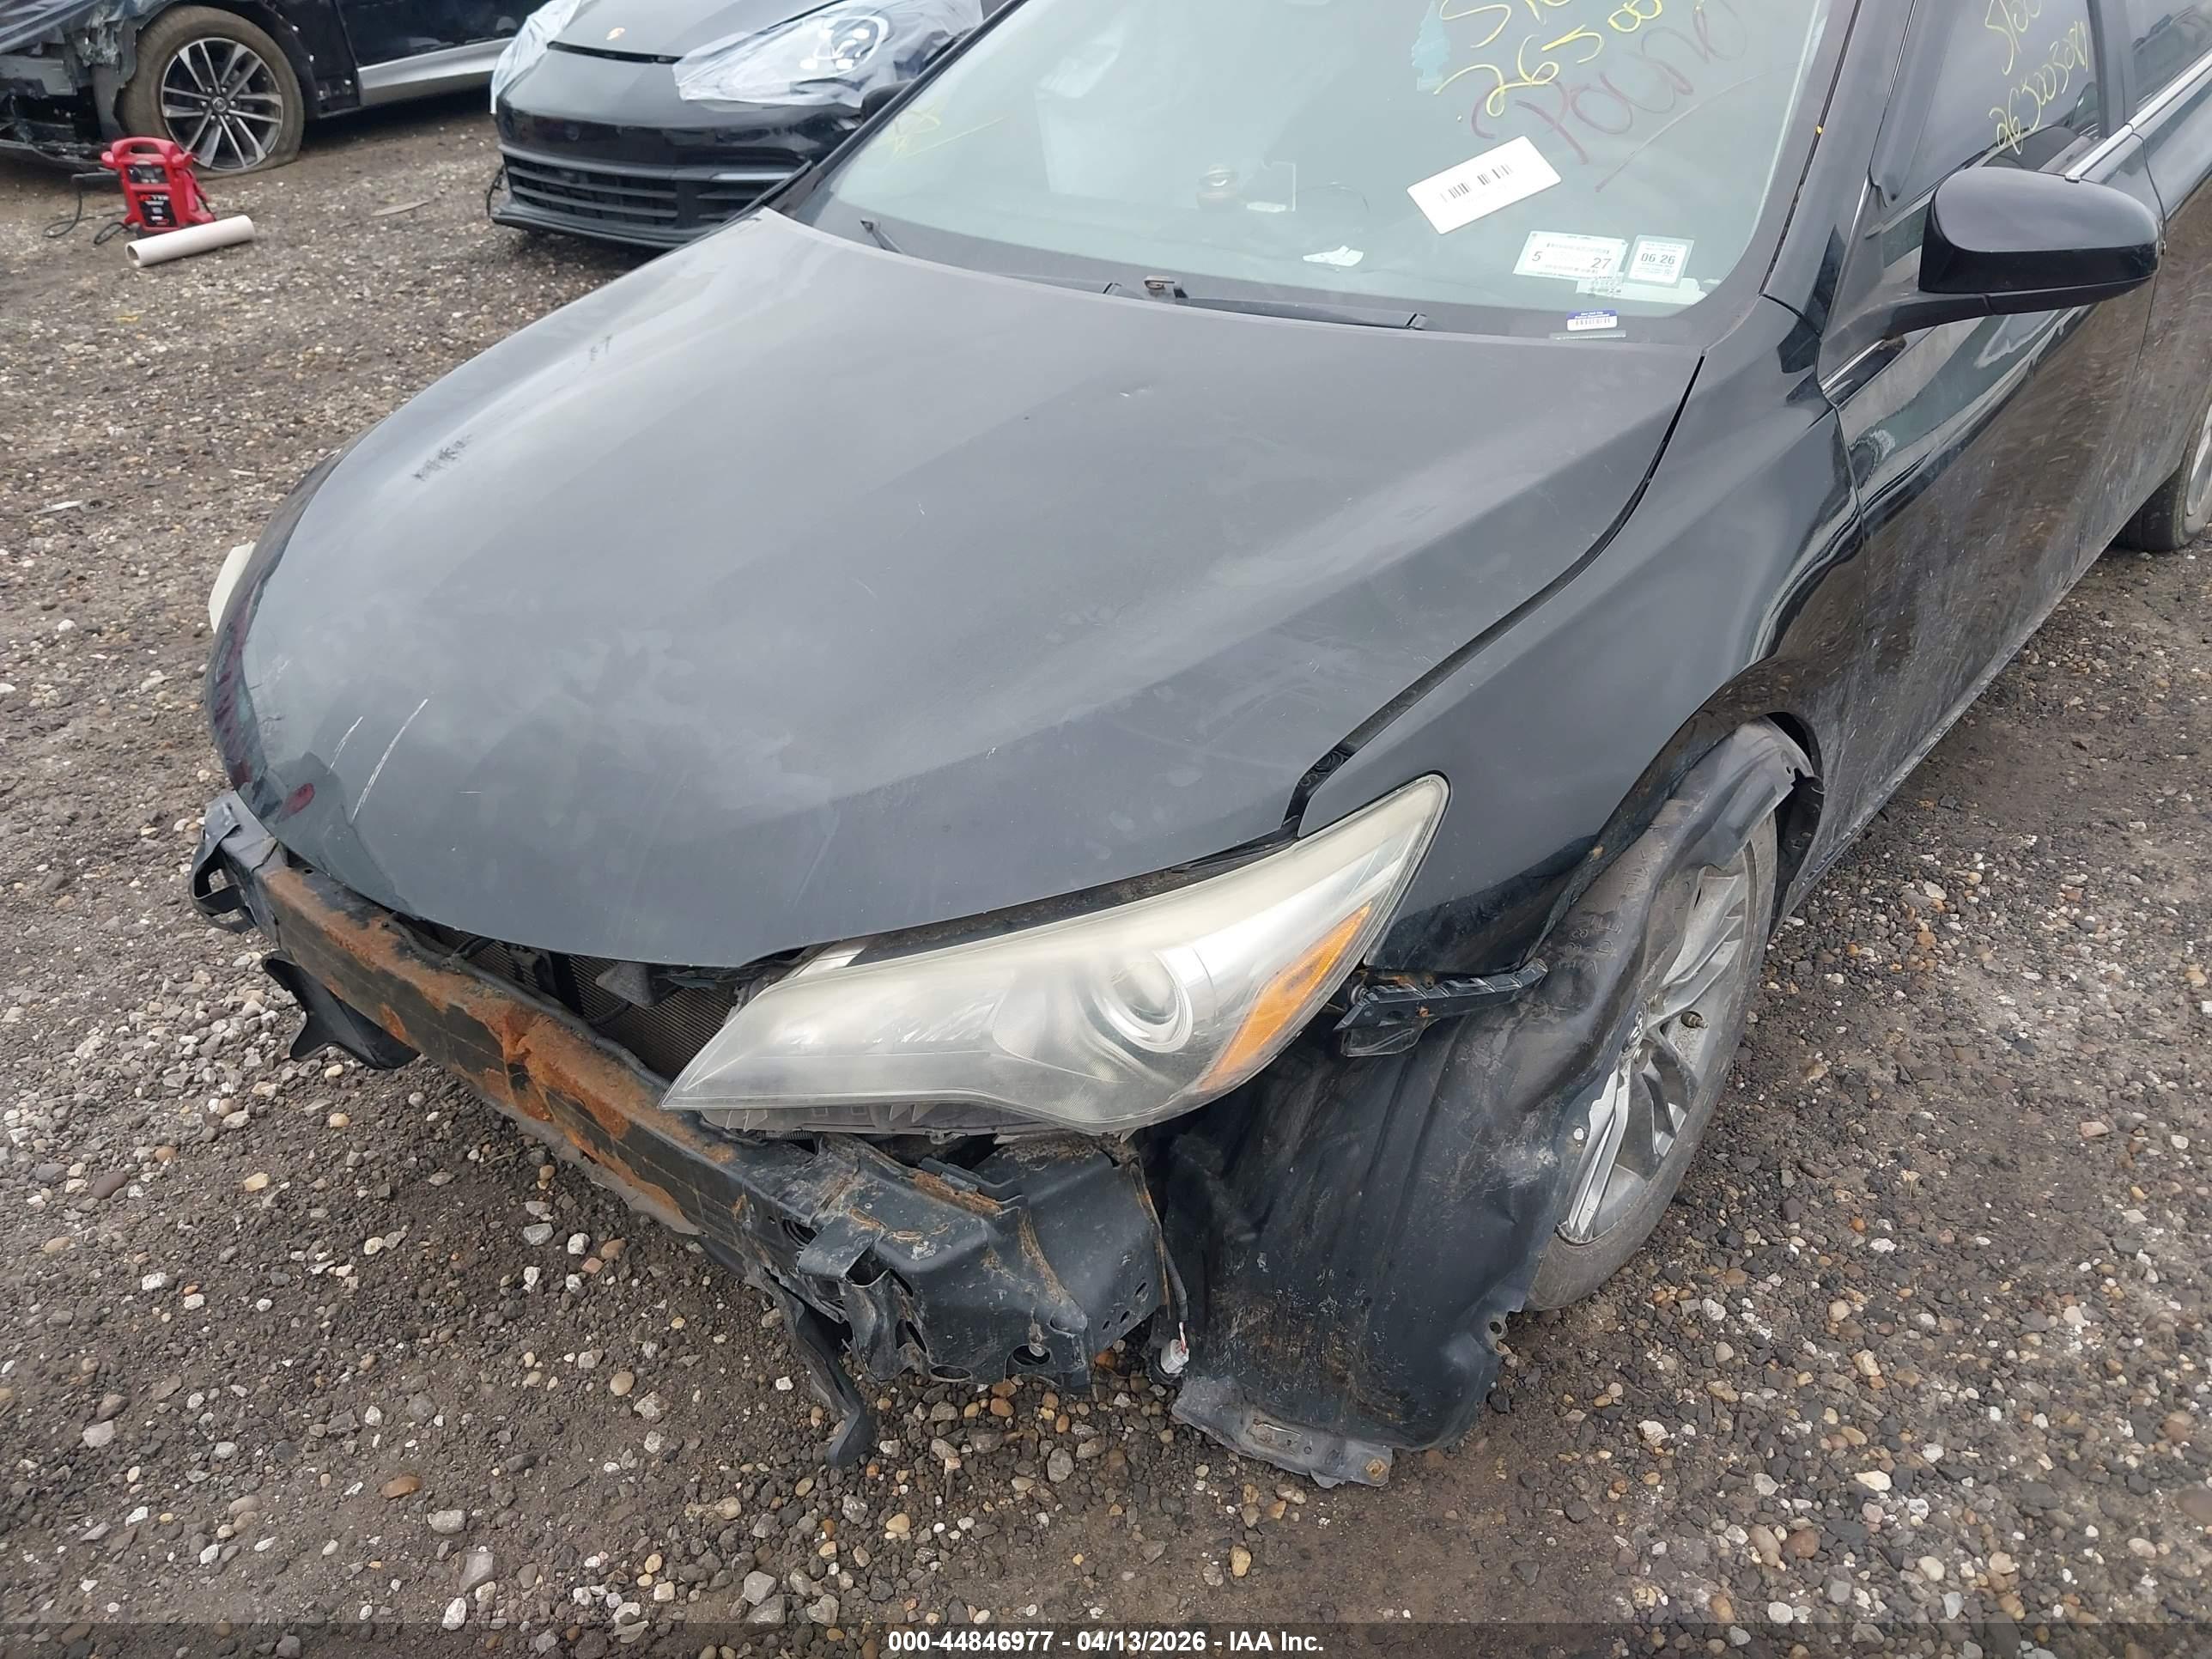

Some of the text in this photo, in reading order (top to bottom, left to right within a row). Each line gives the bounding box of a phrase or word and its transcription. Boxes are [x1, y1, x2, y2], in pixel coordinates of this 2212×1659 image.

[1532, 251, 1543, 262] 5
[1590, 257, 1612, 270] 27
[1640, 252, 1676, 265] 06 26
